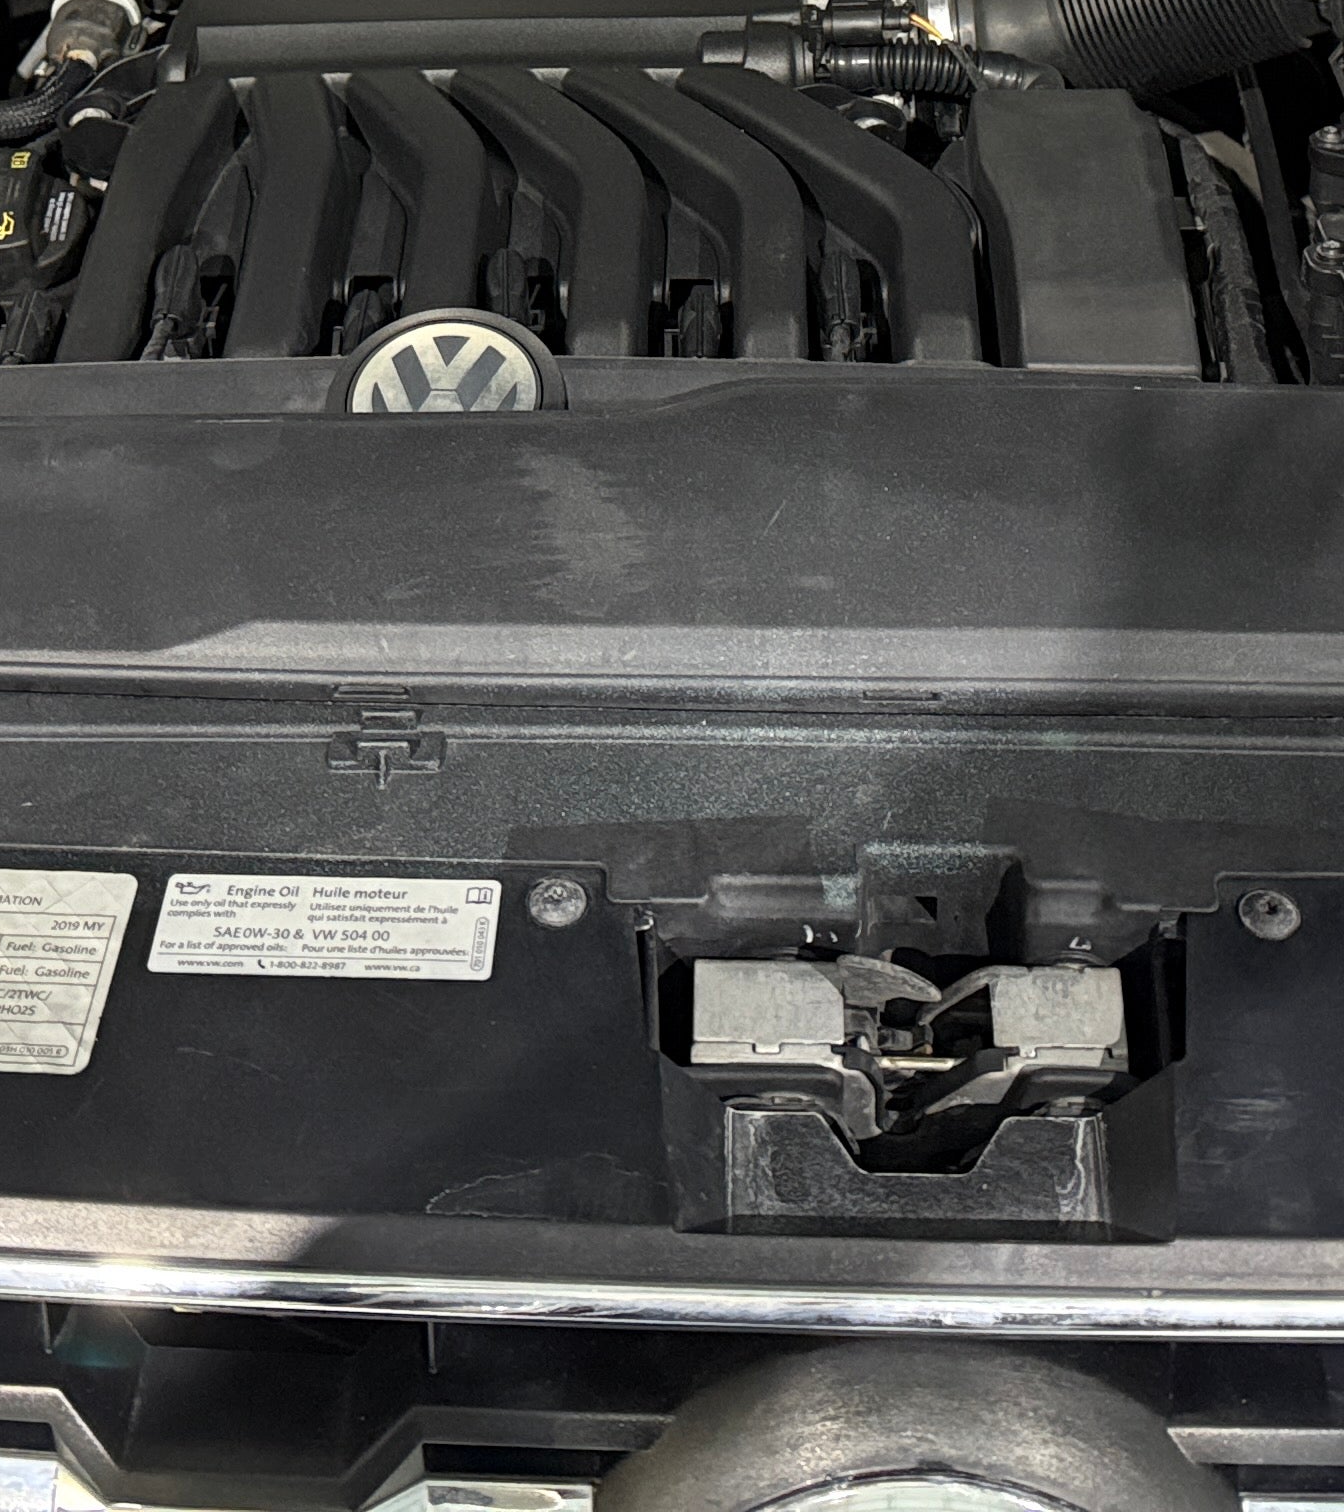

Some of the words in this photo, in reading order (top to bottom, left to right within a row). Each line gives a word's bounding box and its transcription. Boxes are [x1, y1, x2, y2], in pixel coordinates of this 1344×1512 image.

[227, 885, 276, 899] Engine
[279, 886, 300, 897] Oil
[312, 886, 351, 899] Huile
[353, 888, 408, 900] moteur
[170, 899, 189, 907] Use
[190, 899, 212, 909] only
[213, 899, 227, 908] oil
[228, 899, 248, 908] that
[250, 901, 297, 912] expressly
[310, 902, 346, 913] Utilisez
[349, 904, 410, 915] uniquement
[412, 904, 426, 914] de
[167, 909, 212, 920] complies
[213, 909, 236, 918] with
[307, 913, 324, 923] qui
[326, 913, 367, 923] satisfait
[50, 920, 80, 930] 2019
[82, 921, 105, 931] MY
[293, 929, 305, 939] &
[312, 929, 338, 940] VW
[340, 929, 367, 941] 504
[371, 930, 390, 942] 00
[6, 941, 37, 952] Fuel:
[42, 942, 97, 956] Gasoline
[159, 940, 176, 949] For
[177, 942, 185, 950] a
[186, 940, 201, 950] list
[203, 941, 216, 950] of
[216, 942, 265, 953] approved
[301, 944, 325, 953] Pour
[326, 945, 346, 954] une
[348, 944, 368, 954] liste
[34, 966, 90, 980] Gasoline
